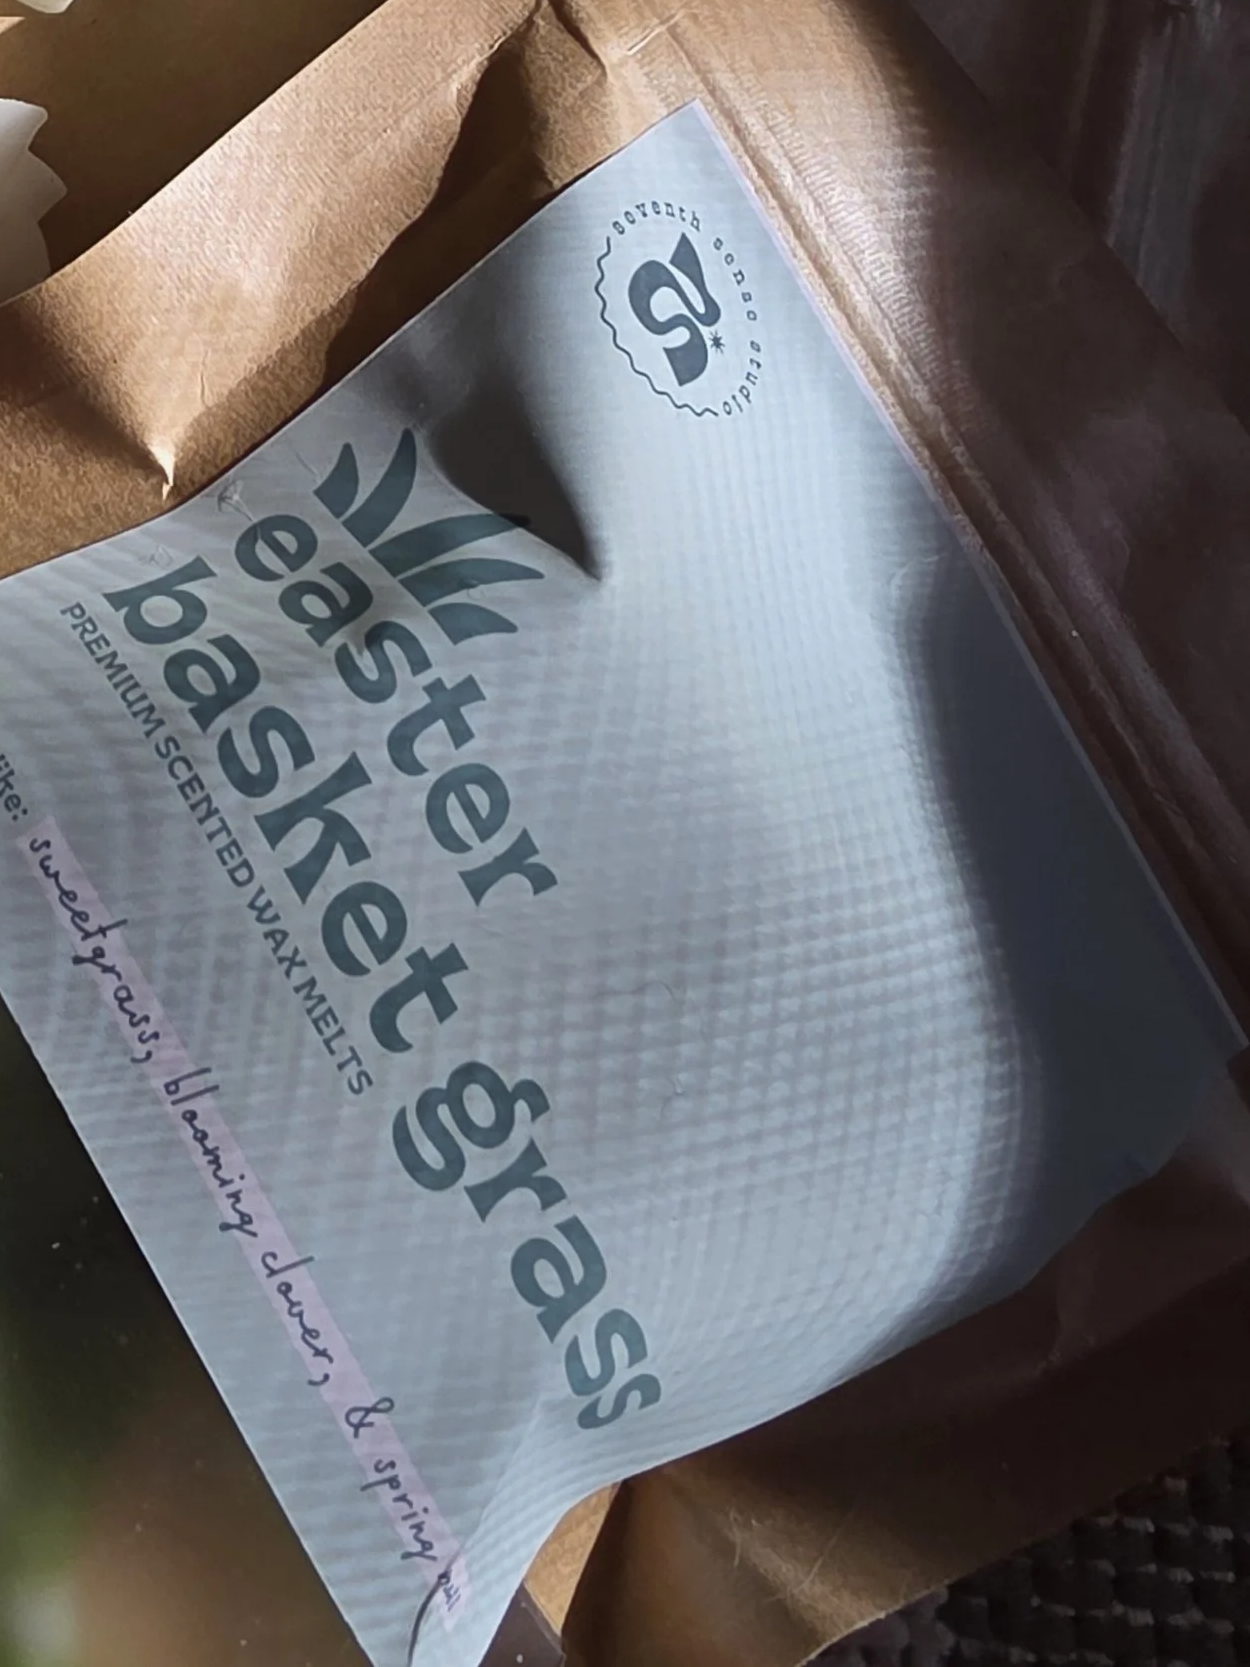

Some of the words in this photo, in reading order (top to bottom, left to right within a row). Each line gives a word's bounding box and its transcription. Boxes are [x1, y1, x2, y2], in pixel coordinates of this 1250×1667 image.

[234, 514, 558, 907] easter
[60, 602, 166, 739] PREMIUM
[154, 734, 257, 888] SCENTED
[246, 886, 311, 978] WAX
[293, 975, 374, 1097] MELTS
[29, 836, 160, 1064] sweetgrass,
[103, 556, 469, 1055] basket
[392, 1059, 662, 1432] grass
[163, 1067, 258, 1239] blooming
[261, 1251, 335, 1388] clover,
[344, 1396, 395, 1439] &
[359, 1458, 439, 1562] spring
